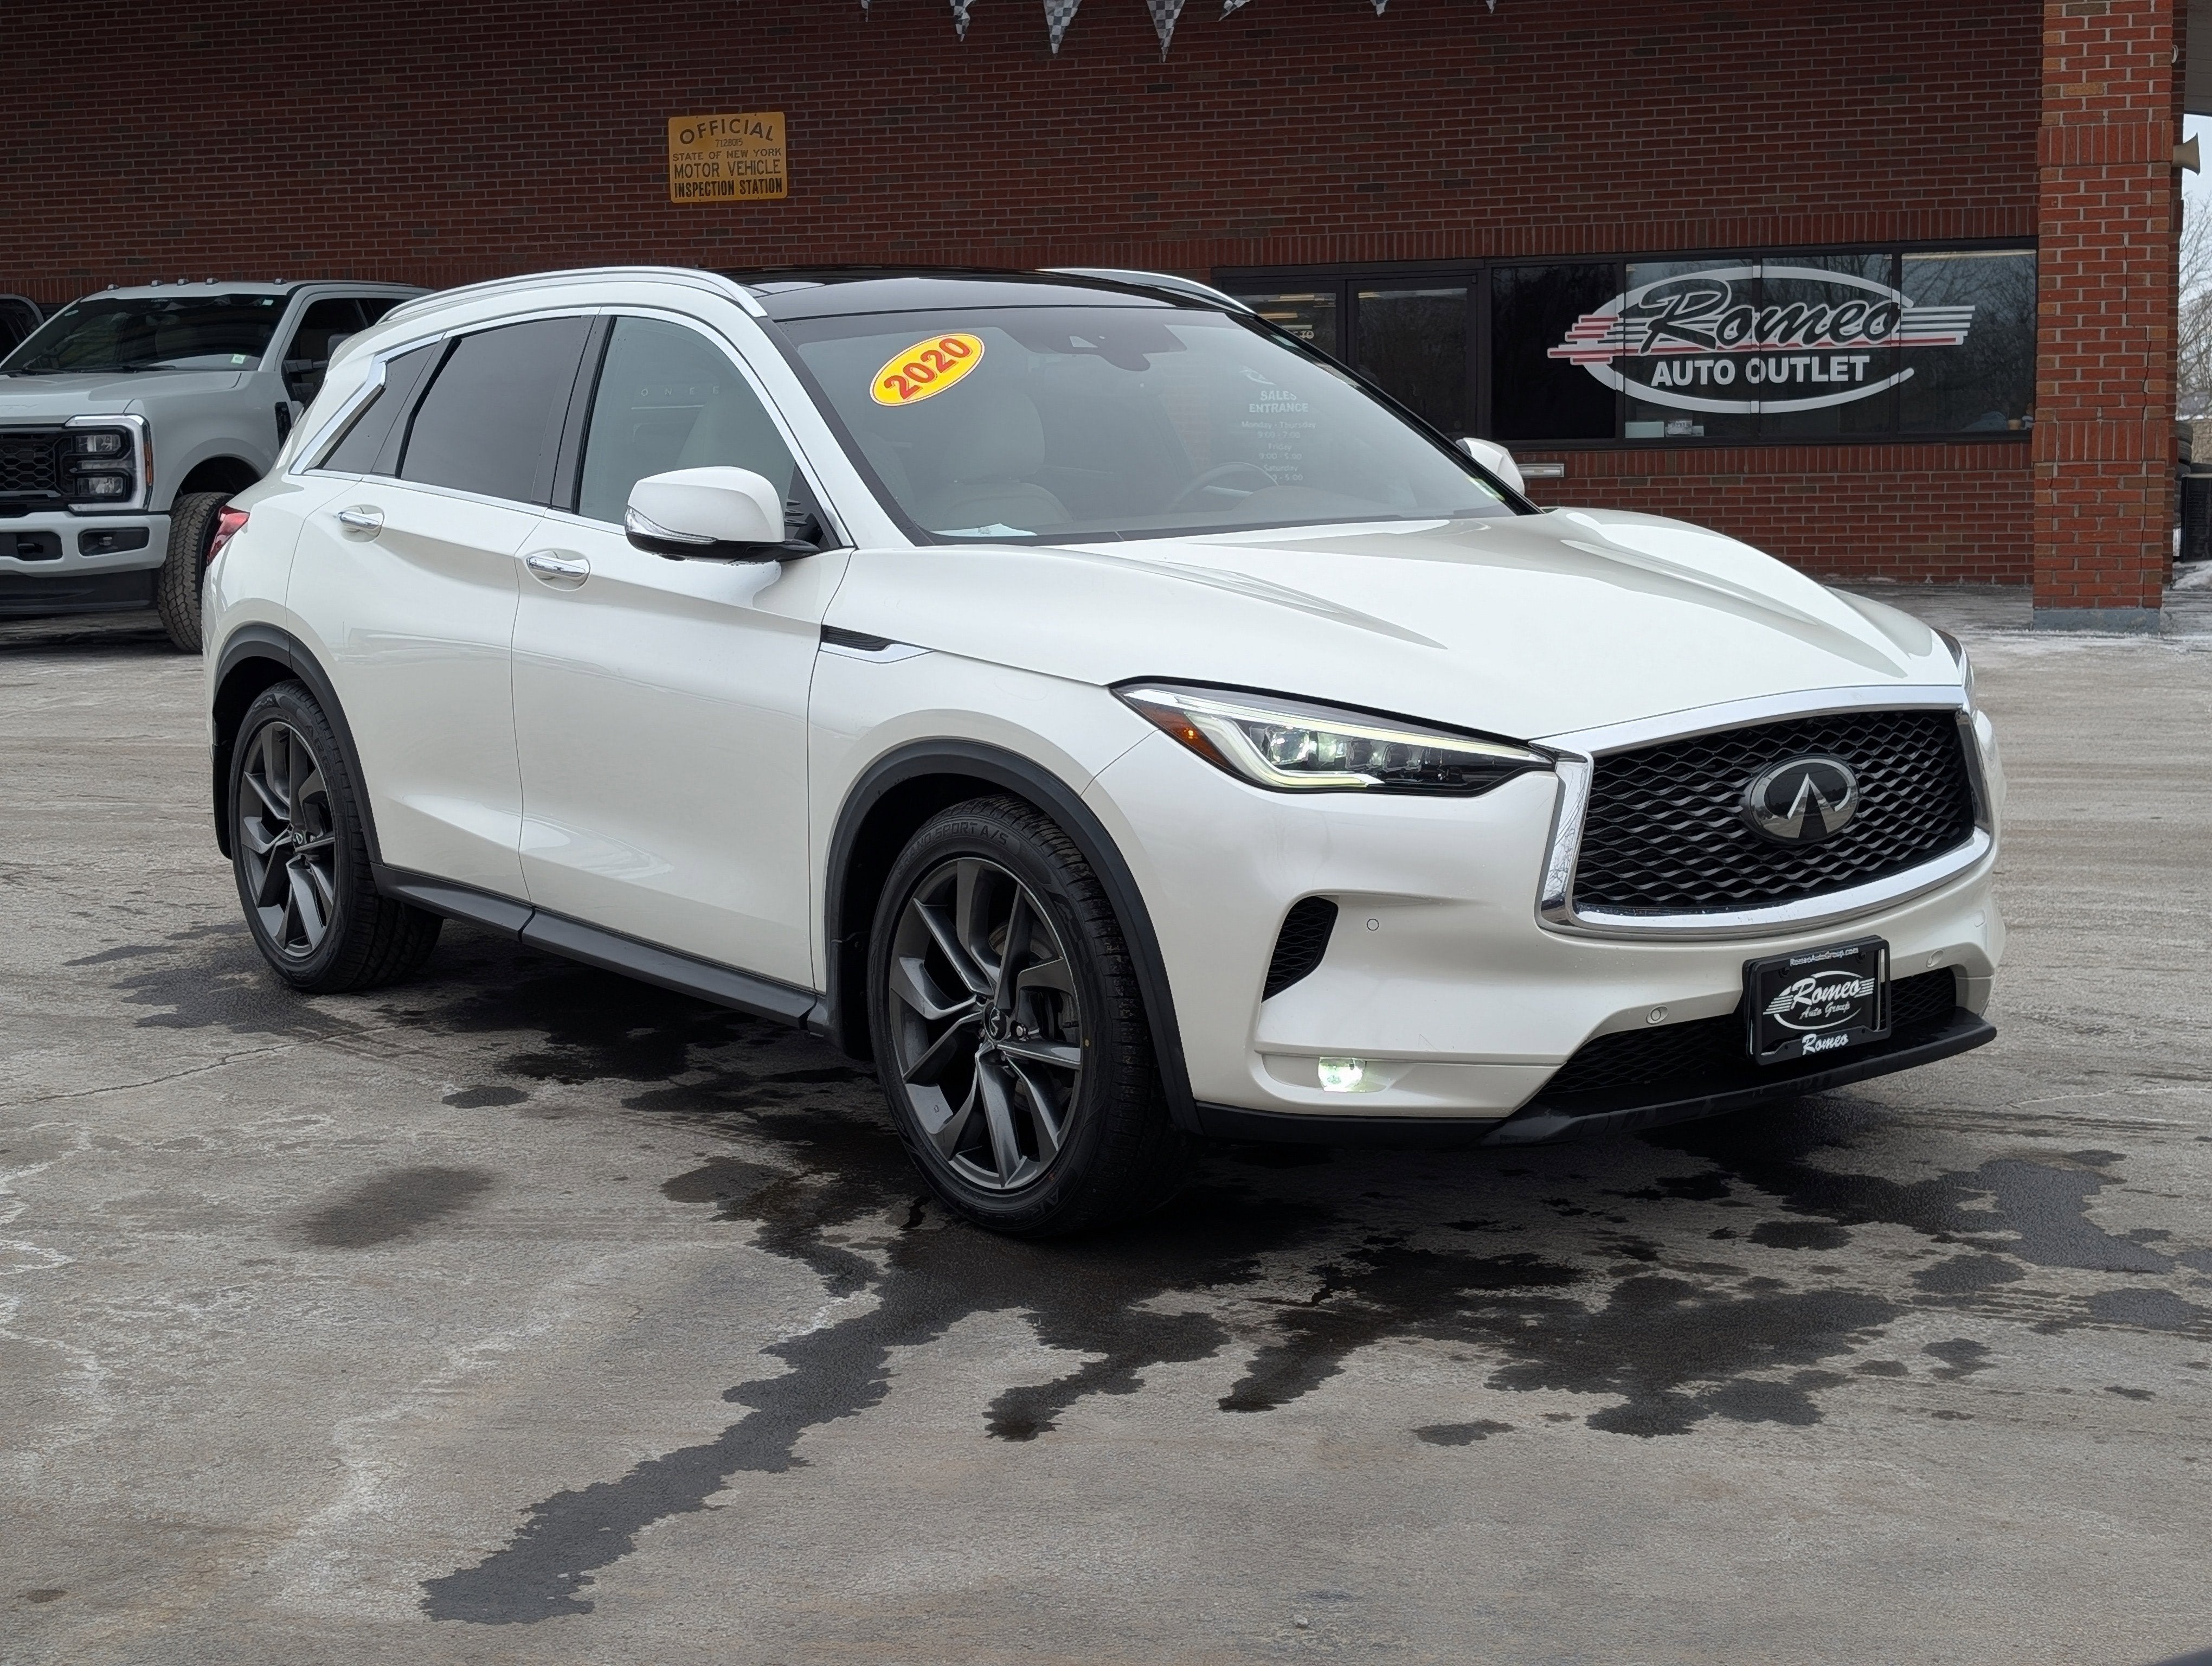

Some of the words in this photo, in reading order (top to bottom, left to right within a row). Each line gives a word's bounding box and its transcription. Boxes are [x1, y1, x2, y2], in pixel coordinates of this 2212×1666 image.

[679, 118, 773, 145] OFFICIAL
[673, 152, 704, 162] STATE
[708, 151, 722, 159] OF
[726, 150, 748, 159] NEW
[753, 147, 782, 157] YORK
[674, 162, 720, 180] MOTOR
[727, 158, 781, 176] VEHICLE
[674, 180, 735, 198] INSPECTION
[740, 177, 782, 195] STATION
[1638, 278, 1901, 356] Romeo
[883, 337, 973, 400] 2020
[1651, 359, 1735, 387] AUTO
[1745, 355, 1870, 383] OUTLET
[1259, 390, 1297, 401] SALES
[1249, 402, 1309, 413] ENTRANCE
[934, 822, 978, 839] SPORT
[980, 825, 1009, 845] A/S
[1791, 977, 1861, 1010] Romeo
[1798, 1005, 1822, 1020] Auto
[1802, 1033, 1849, 1055] Romeo
